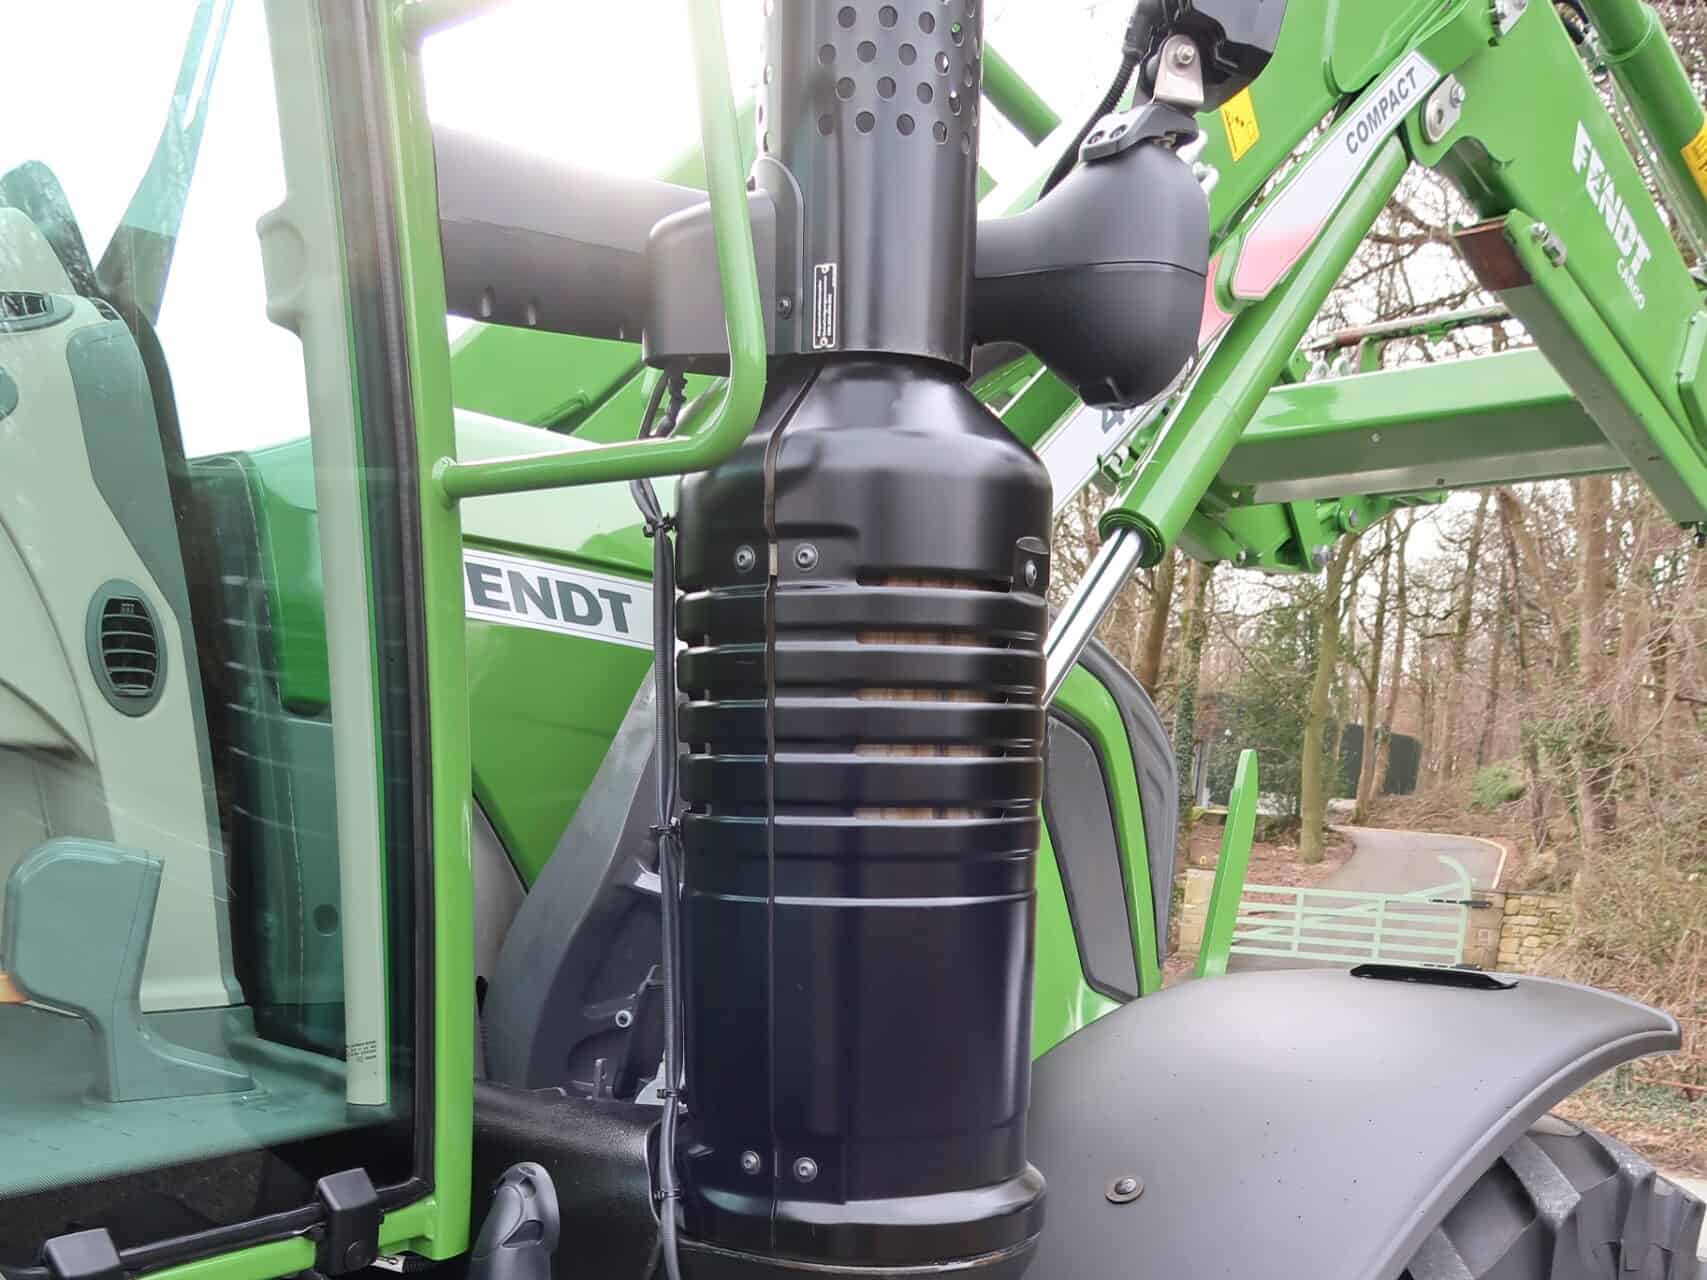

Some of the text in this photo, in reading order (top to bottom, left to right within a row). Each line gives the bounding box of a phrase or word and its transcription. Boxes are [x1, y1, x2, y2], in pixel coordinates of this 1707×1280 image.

[1346, 66, 1416, 154] COMPACT
[1572, 119, 1651, 276] FENDT
[464, 561, 633, 634] ENDT
